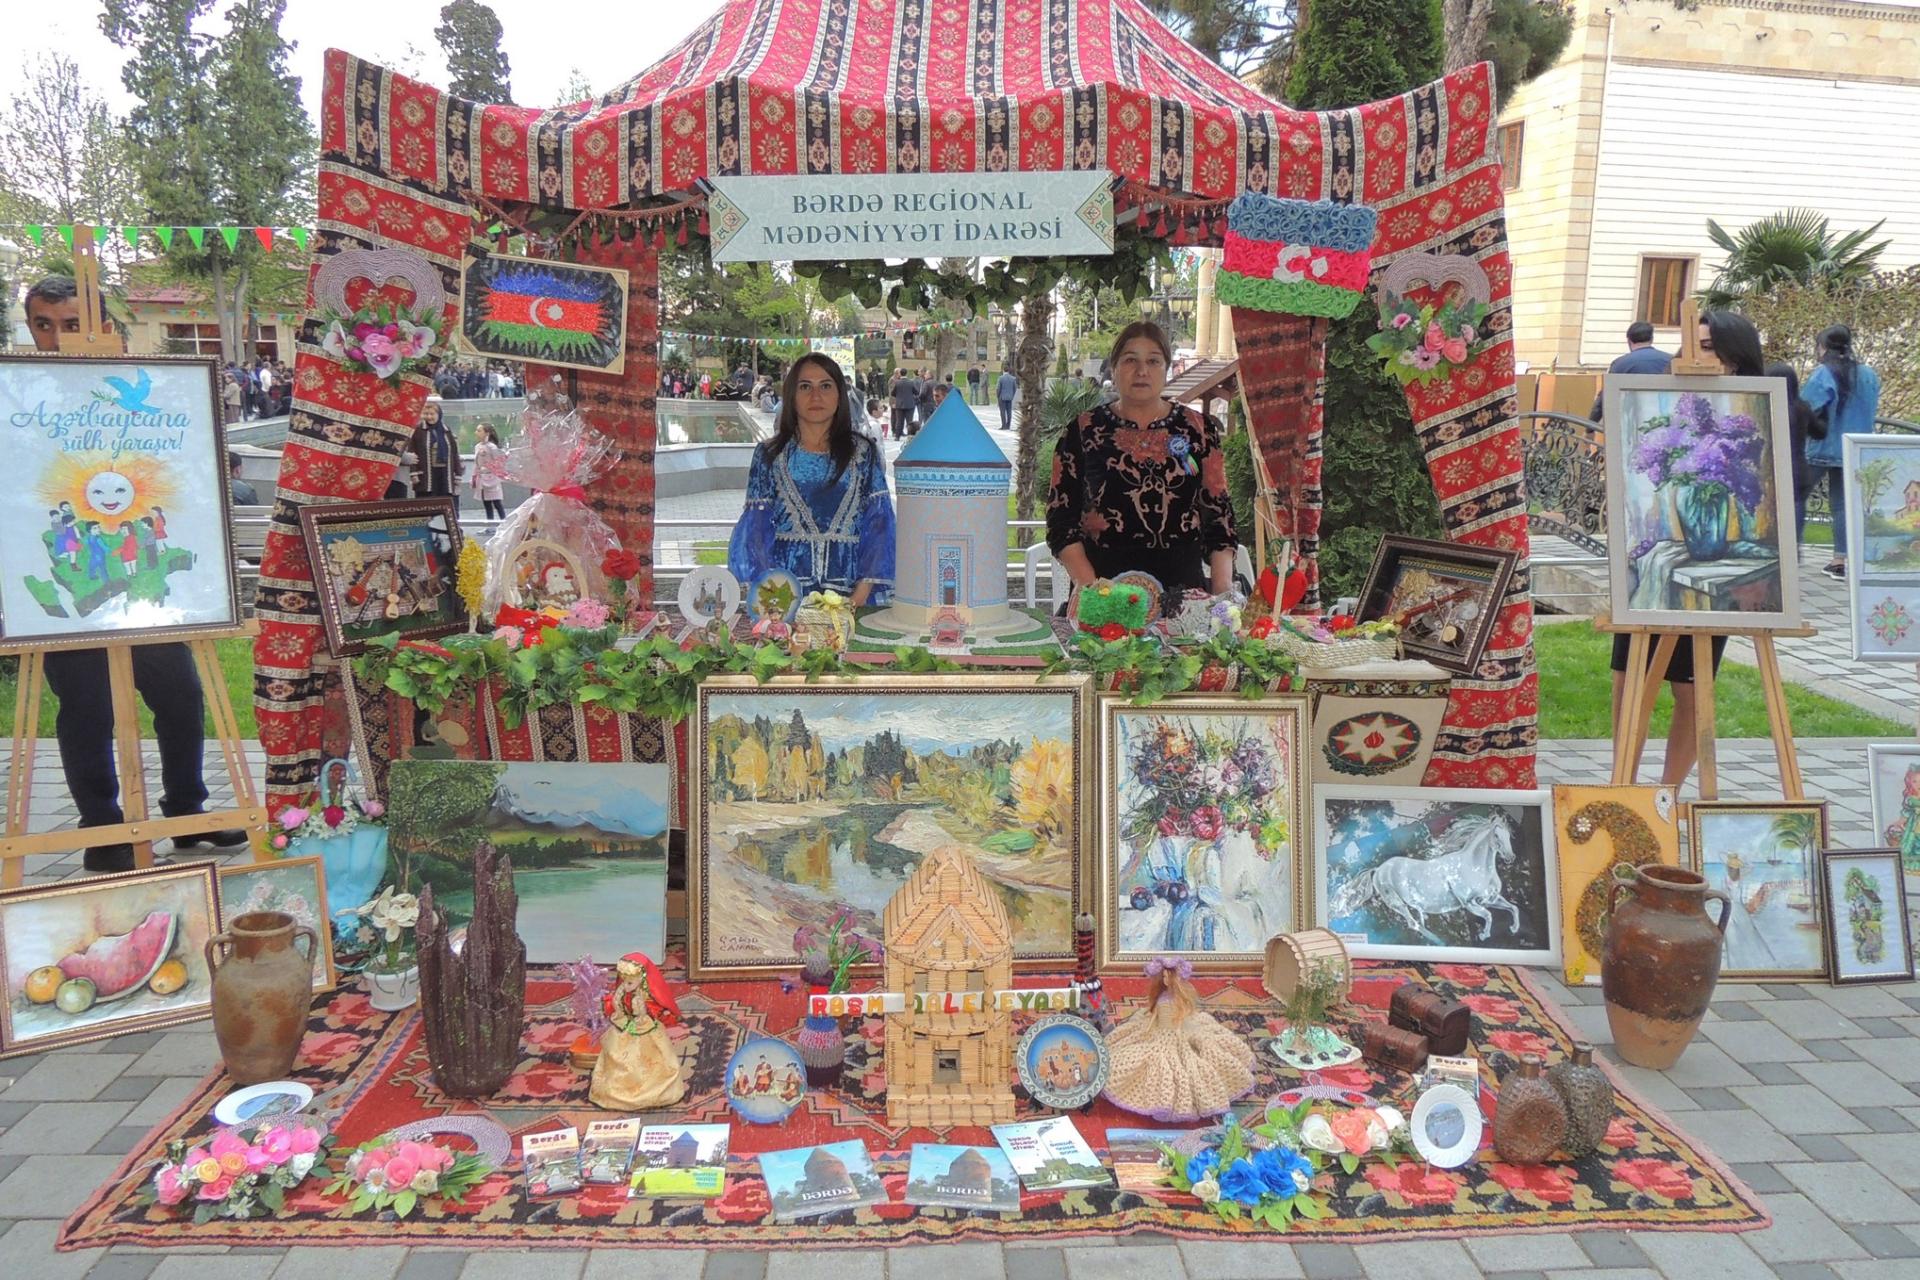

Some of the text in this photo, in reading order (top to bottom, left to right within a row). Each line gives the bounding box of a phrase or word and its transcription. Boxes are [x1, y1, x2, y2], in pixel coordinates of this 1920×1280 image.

[792, 188, 1033, 214] BƏRDƏ REGİONAL
[762, 217, 1063, 244] MƏDƏNİYYƏT İDARƏSİ
[10, 400, 190, 438] Azərbaycana
[62, 430, 184, 459] sülh yaraşır!
[801, 1186, 853, 1202] BƏRDƏ
[936, 1185, 988, 1197] BƏRDƏ
